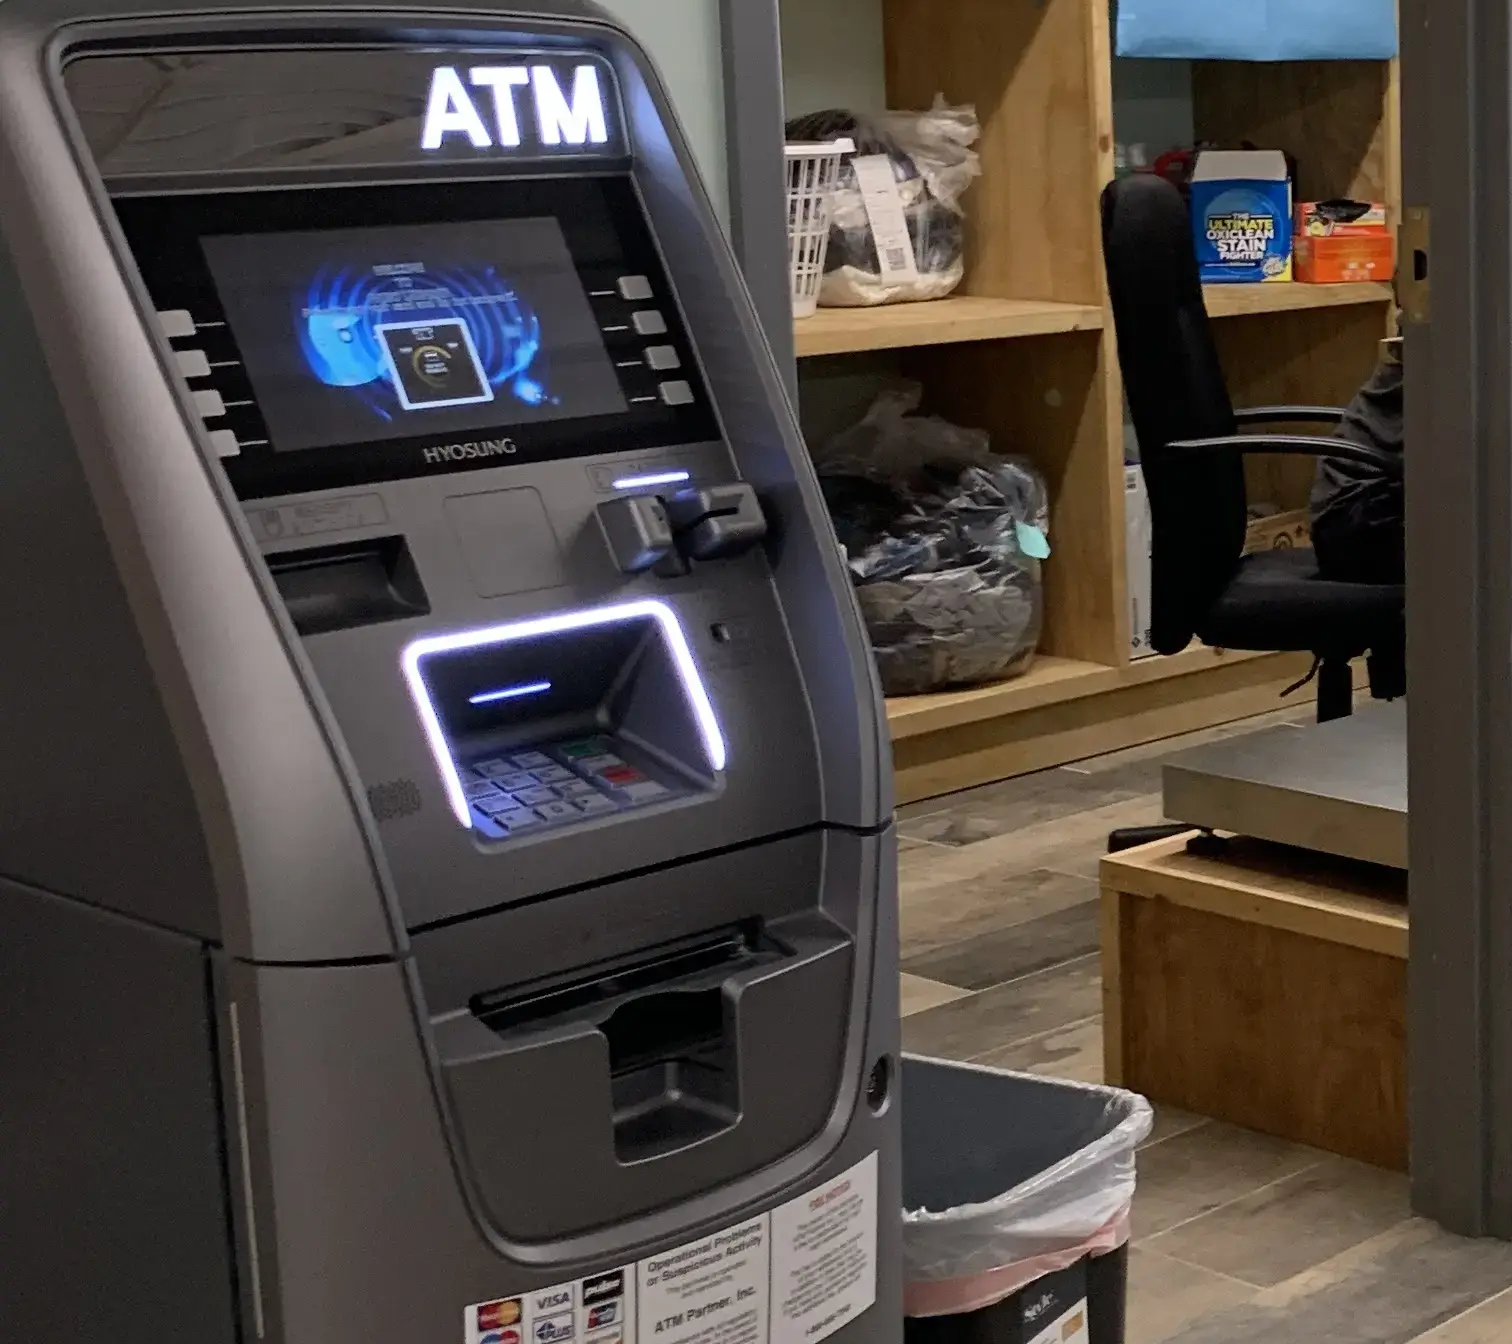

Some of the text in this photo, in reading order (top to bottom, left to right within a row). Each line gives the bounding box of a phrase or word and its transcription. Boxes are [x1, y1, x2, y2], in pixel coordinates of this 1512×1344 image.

[421, 65, 608, 149] ATM
[1206, 229, 1275, 240] OXICLEAN
[1208, 220, 1274, 230] ULTIMATE
[1217, 239, 1267, 252] STAIN
[1219, 251, 1264, 260] FIGHTER
[422, 438, 517, 464] HYOSUNG
[647, 1240, 712, 1272] Operational
[714, 1222, 762, 1249] Problems
[646, 1276, 659, 1287] or
[662, 1252, 723, 1282] Suspicious
[726, 1234, 763, 1257] Activity
[537, 1291, 570, 1310] VISA
[654, 1313, 683, 1334] ATM
